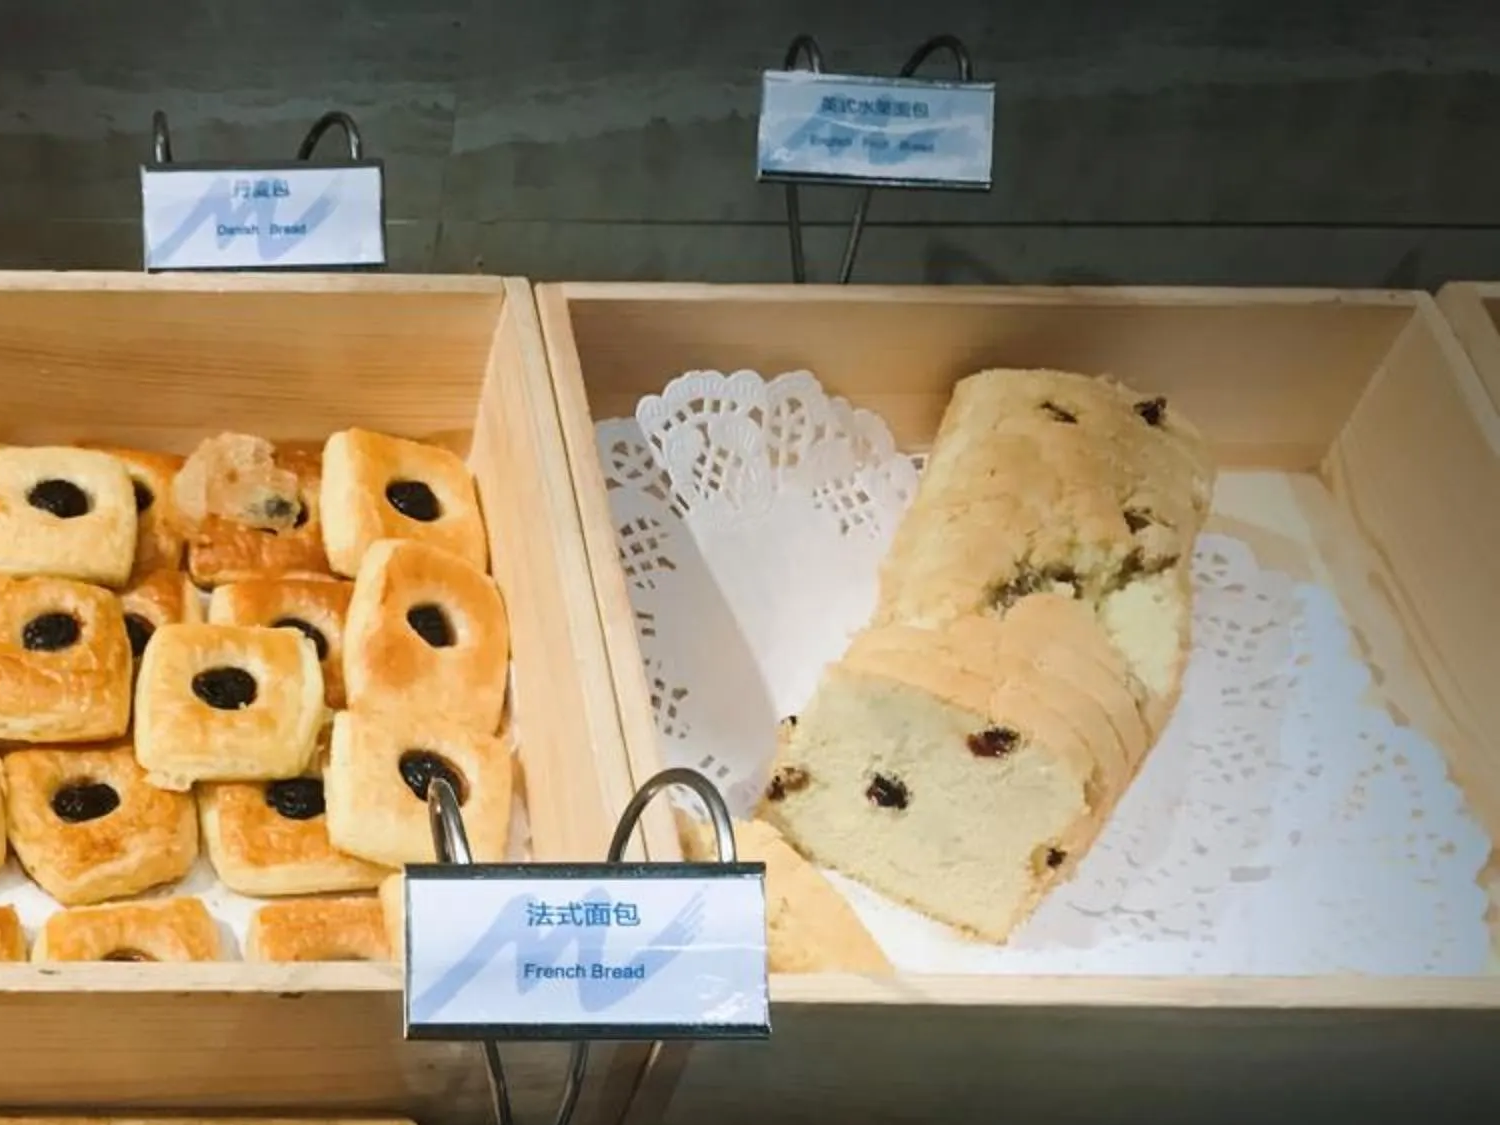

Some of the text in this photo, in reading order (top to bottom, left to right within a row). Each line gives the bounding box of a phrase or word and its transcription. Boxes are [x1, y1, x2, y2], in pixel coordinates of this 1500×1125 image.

[525, 901, 641, 927] 法式面包
[523, 963, 645, 979] French Bread
